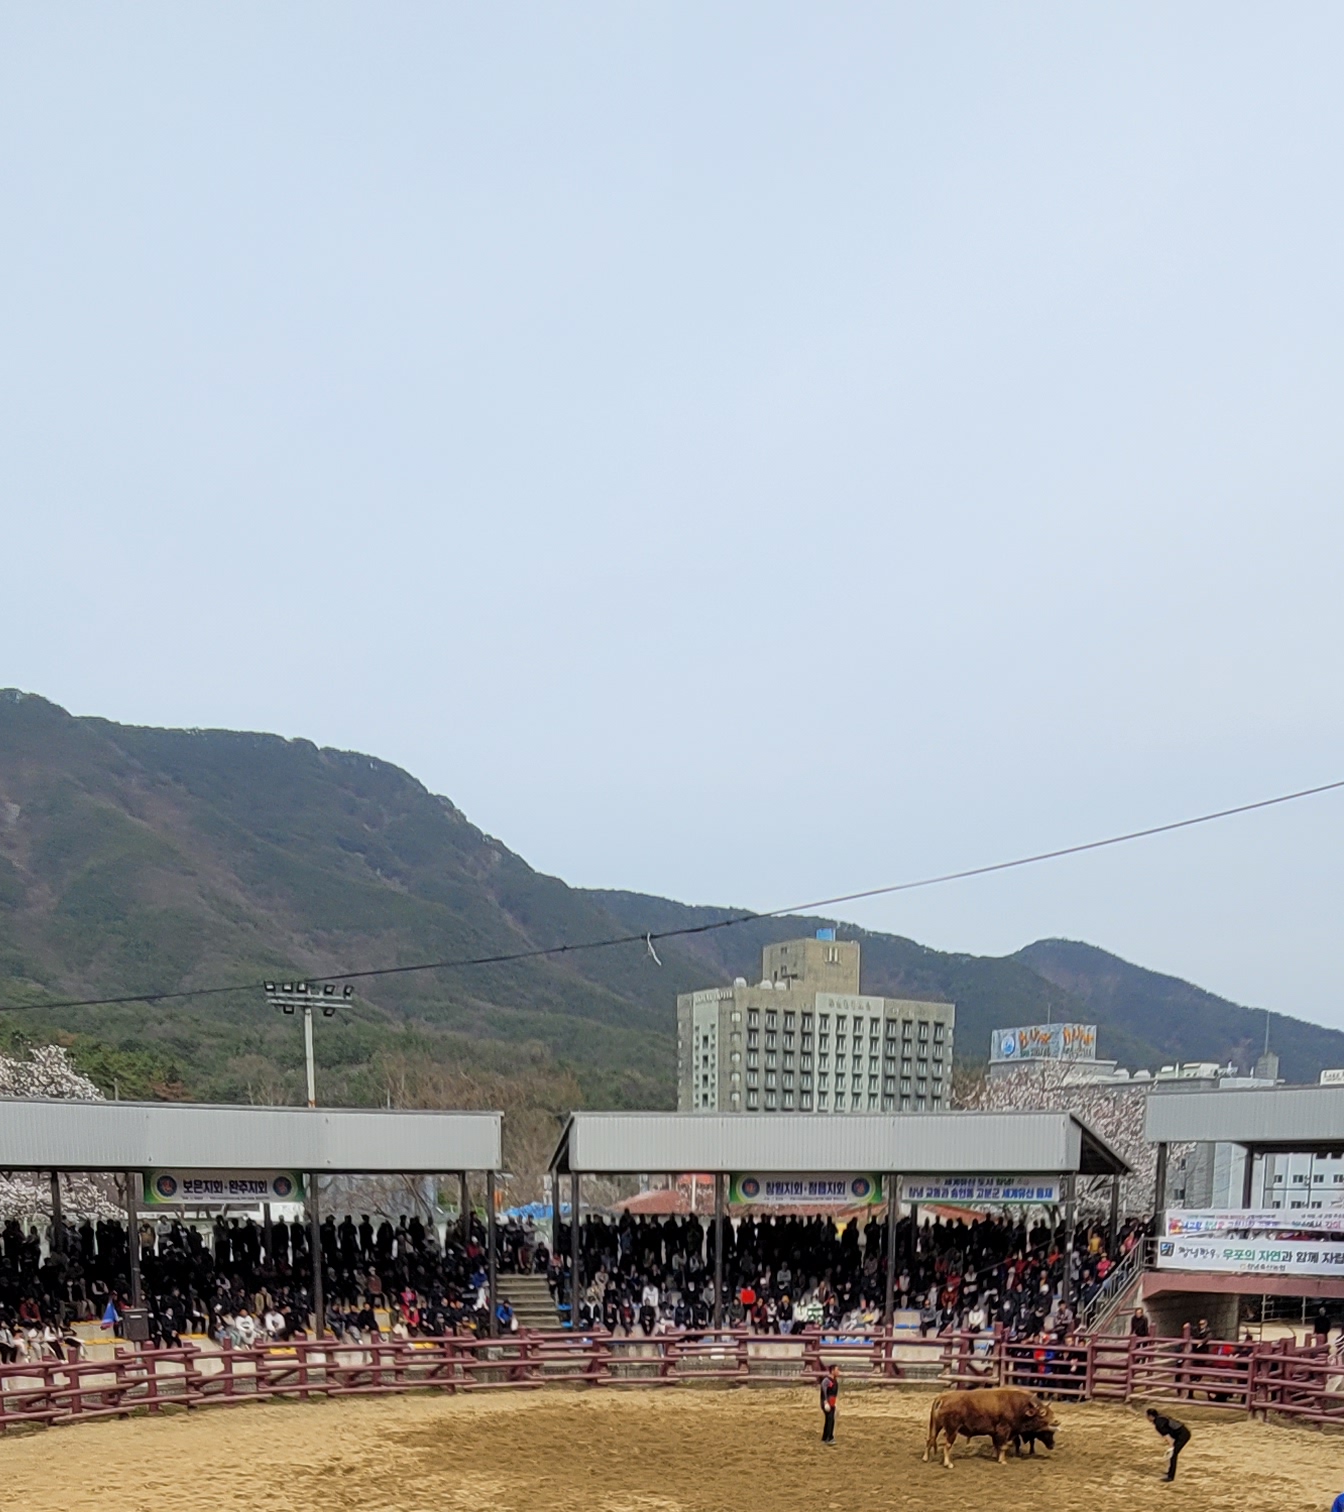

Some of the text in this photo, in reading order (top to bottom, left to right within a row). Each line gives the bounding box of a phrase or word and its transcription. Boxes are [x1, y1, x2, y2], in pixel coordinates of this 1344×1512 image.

[1222, 1248, 1256, 1261] 우포의
[1258, 1249, 1293, 1262] 자연과
[1296, 1251, 1319, 1264] 함께
